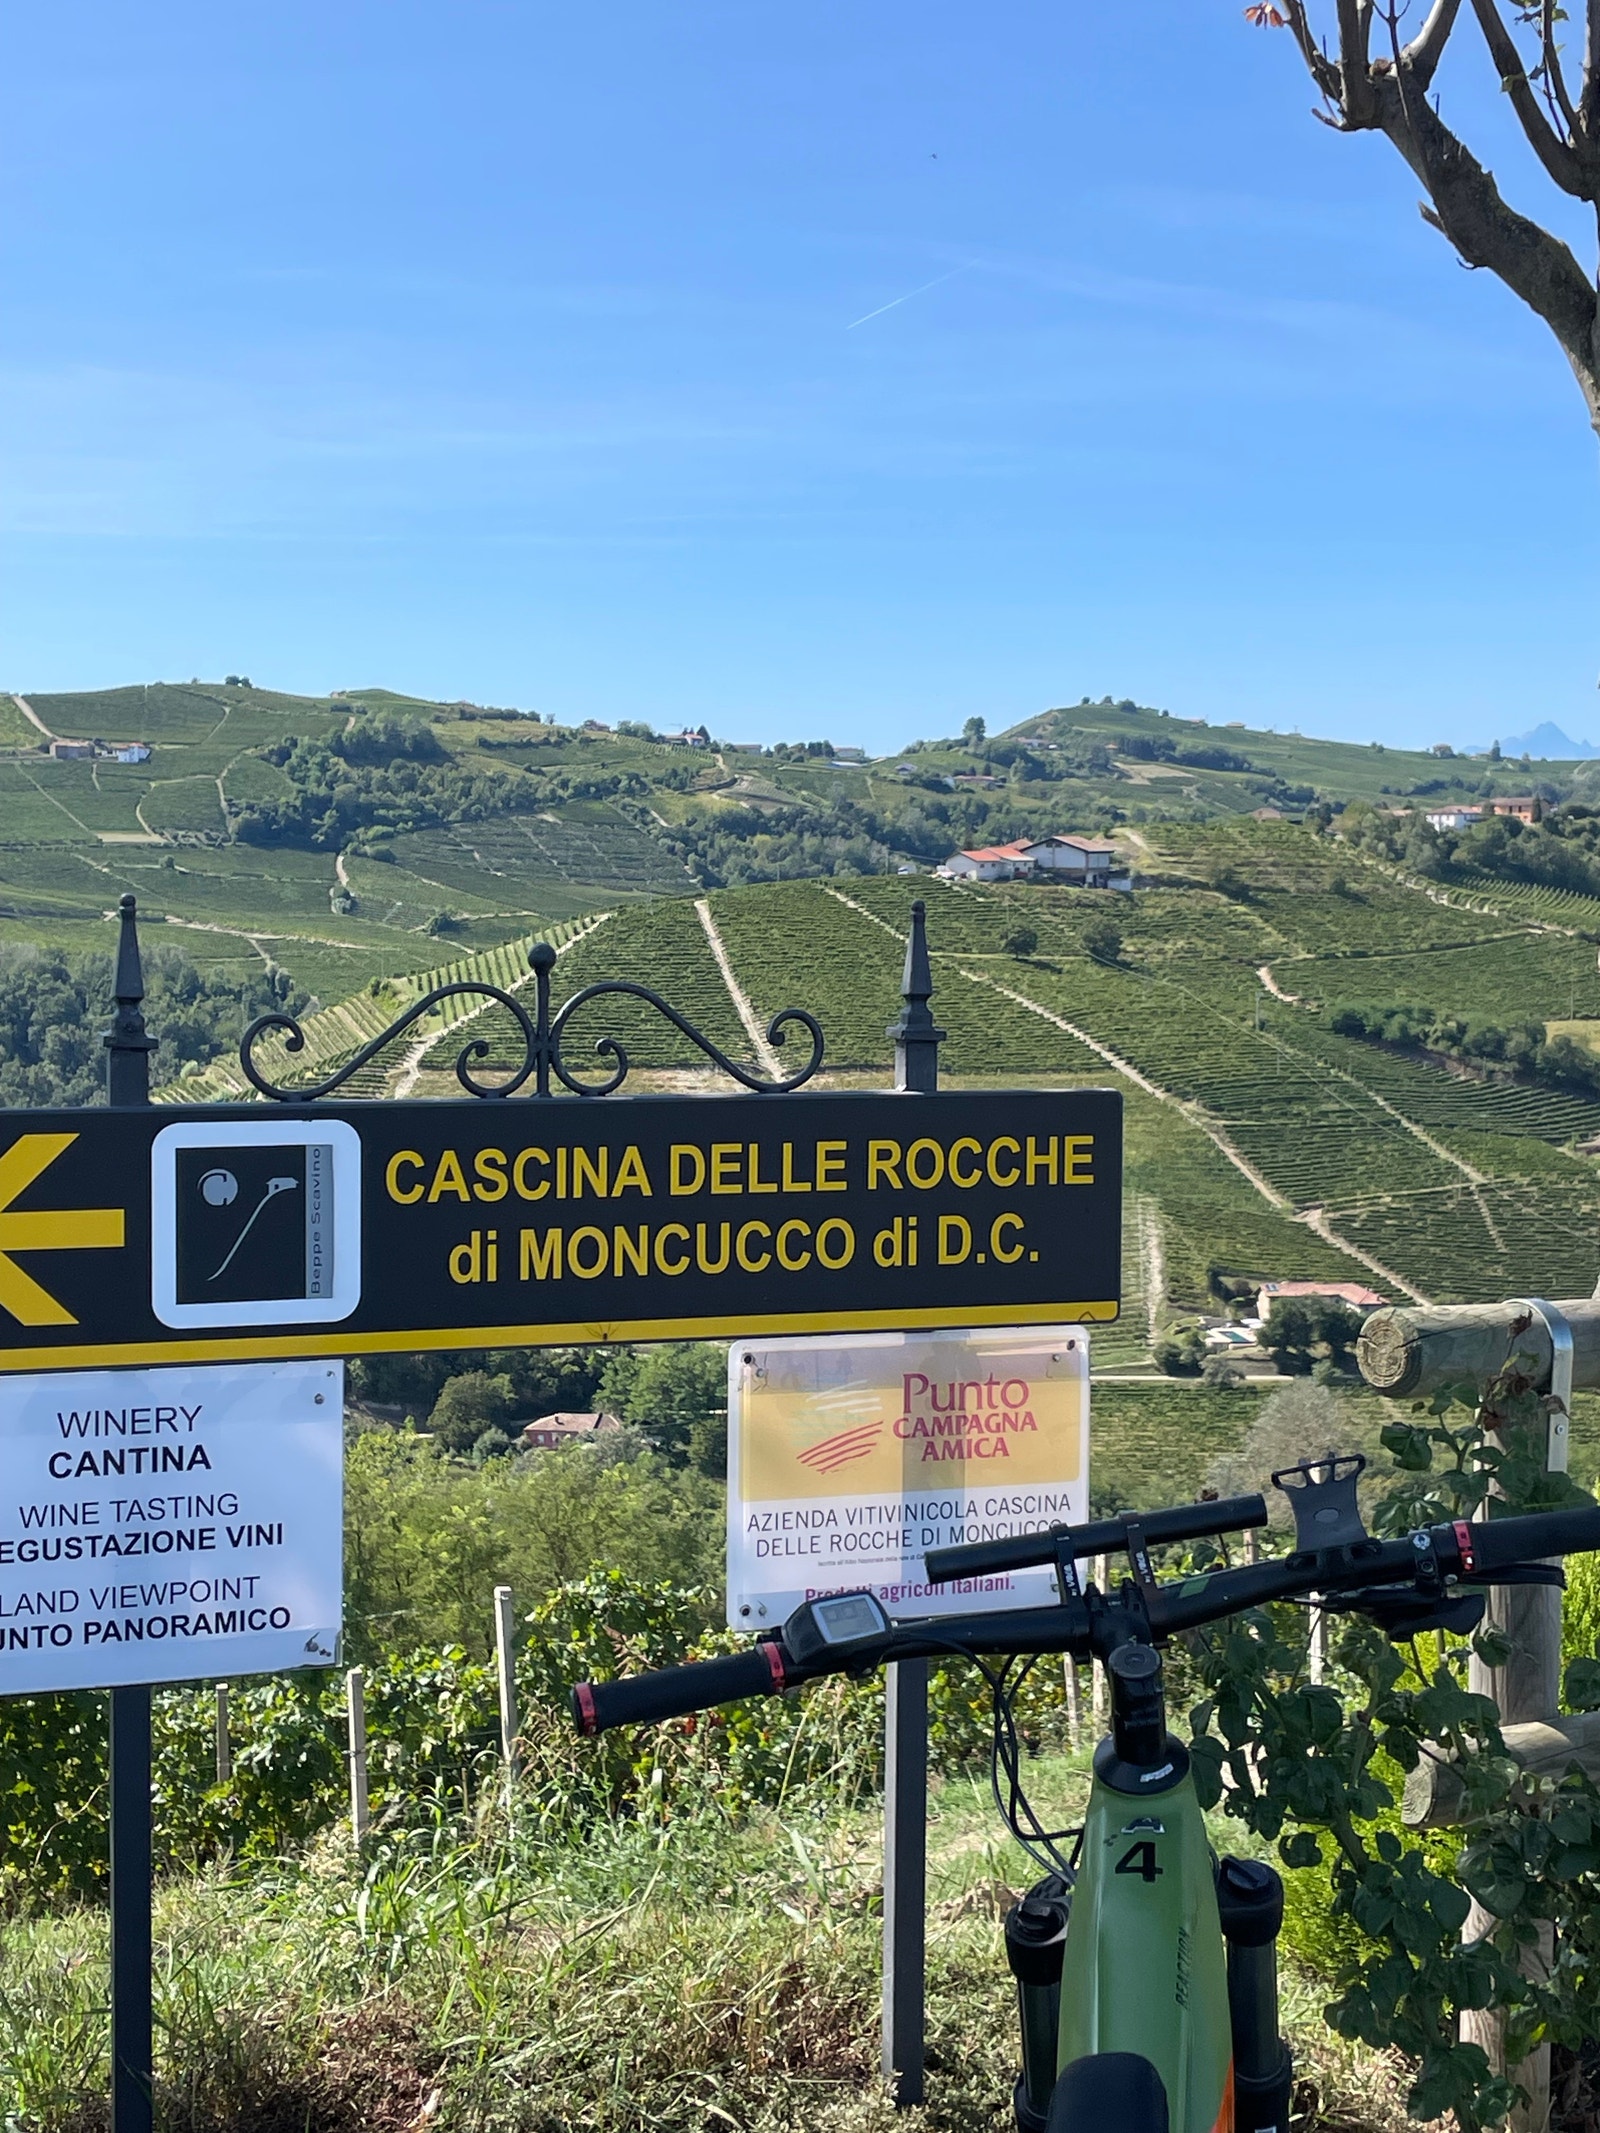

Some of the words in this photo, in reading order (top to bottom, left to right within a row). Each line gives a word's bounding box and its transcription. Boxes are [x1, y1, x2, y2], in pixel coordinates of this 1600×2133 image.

[311, 1148, 321, 1224] Scavino
[385, 1145, 653, 1204] CASCINA
[670, 1140, 848, 1195] DELLE
[867, 1135, 1095, 1190] ROCCHE
[311, 1231, 322, 1294] Beppe
[450, 1230, 498, 1284] di
[520, 1218, 856, 1280] MONCUCCO
[873, 1216, 918, 1268] di
[938, 1213, 1039, 1265] D.C.
[903, 1372, 1029, 1414] Punto
[57, 1405, 203, 1438] WINERY
[893, 1411, 1038, 1439] CAMPAGNA
[49, 1444, 212, 1479] CANTINA
[921, 1437, 1010, 1462] AMICA
[19, 1502, 100, 1529] WINE
[109, 1493, 239, 1523] TASTING
[747, 1509, 838, 1532] AZIENDA
[845, 1500, 978, 1526] VITIVINICOLA
[985, 1494, 1071, 1516] CASCINA
[226, 1523, 283, 1548] VINI
[756, 1535, 821, 1557] DELLE
[830, 1528, 912, 1552] ROCCHE
[921, 1527, 940, 1546] DI
[89, 1576, 260, 1610] VIEWPOINT
[0, 1624, 73, 1650] NTO
[83, 1607, 291, 1644] PANORAMICO
[1114, 1841, 1163, 1883] 4
